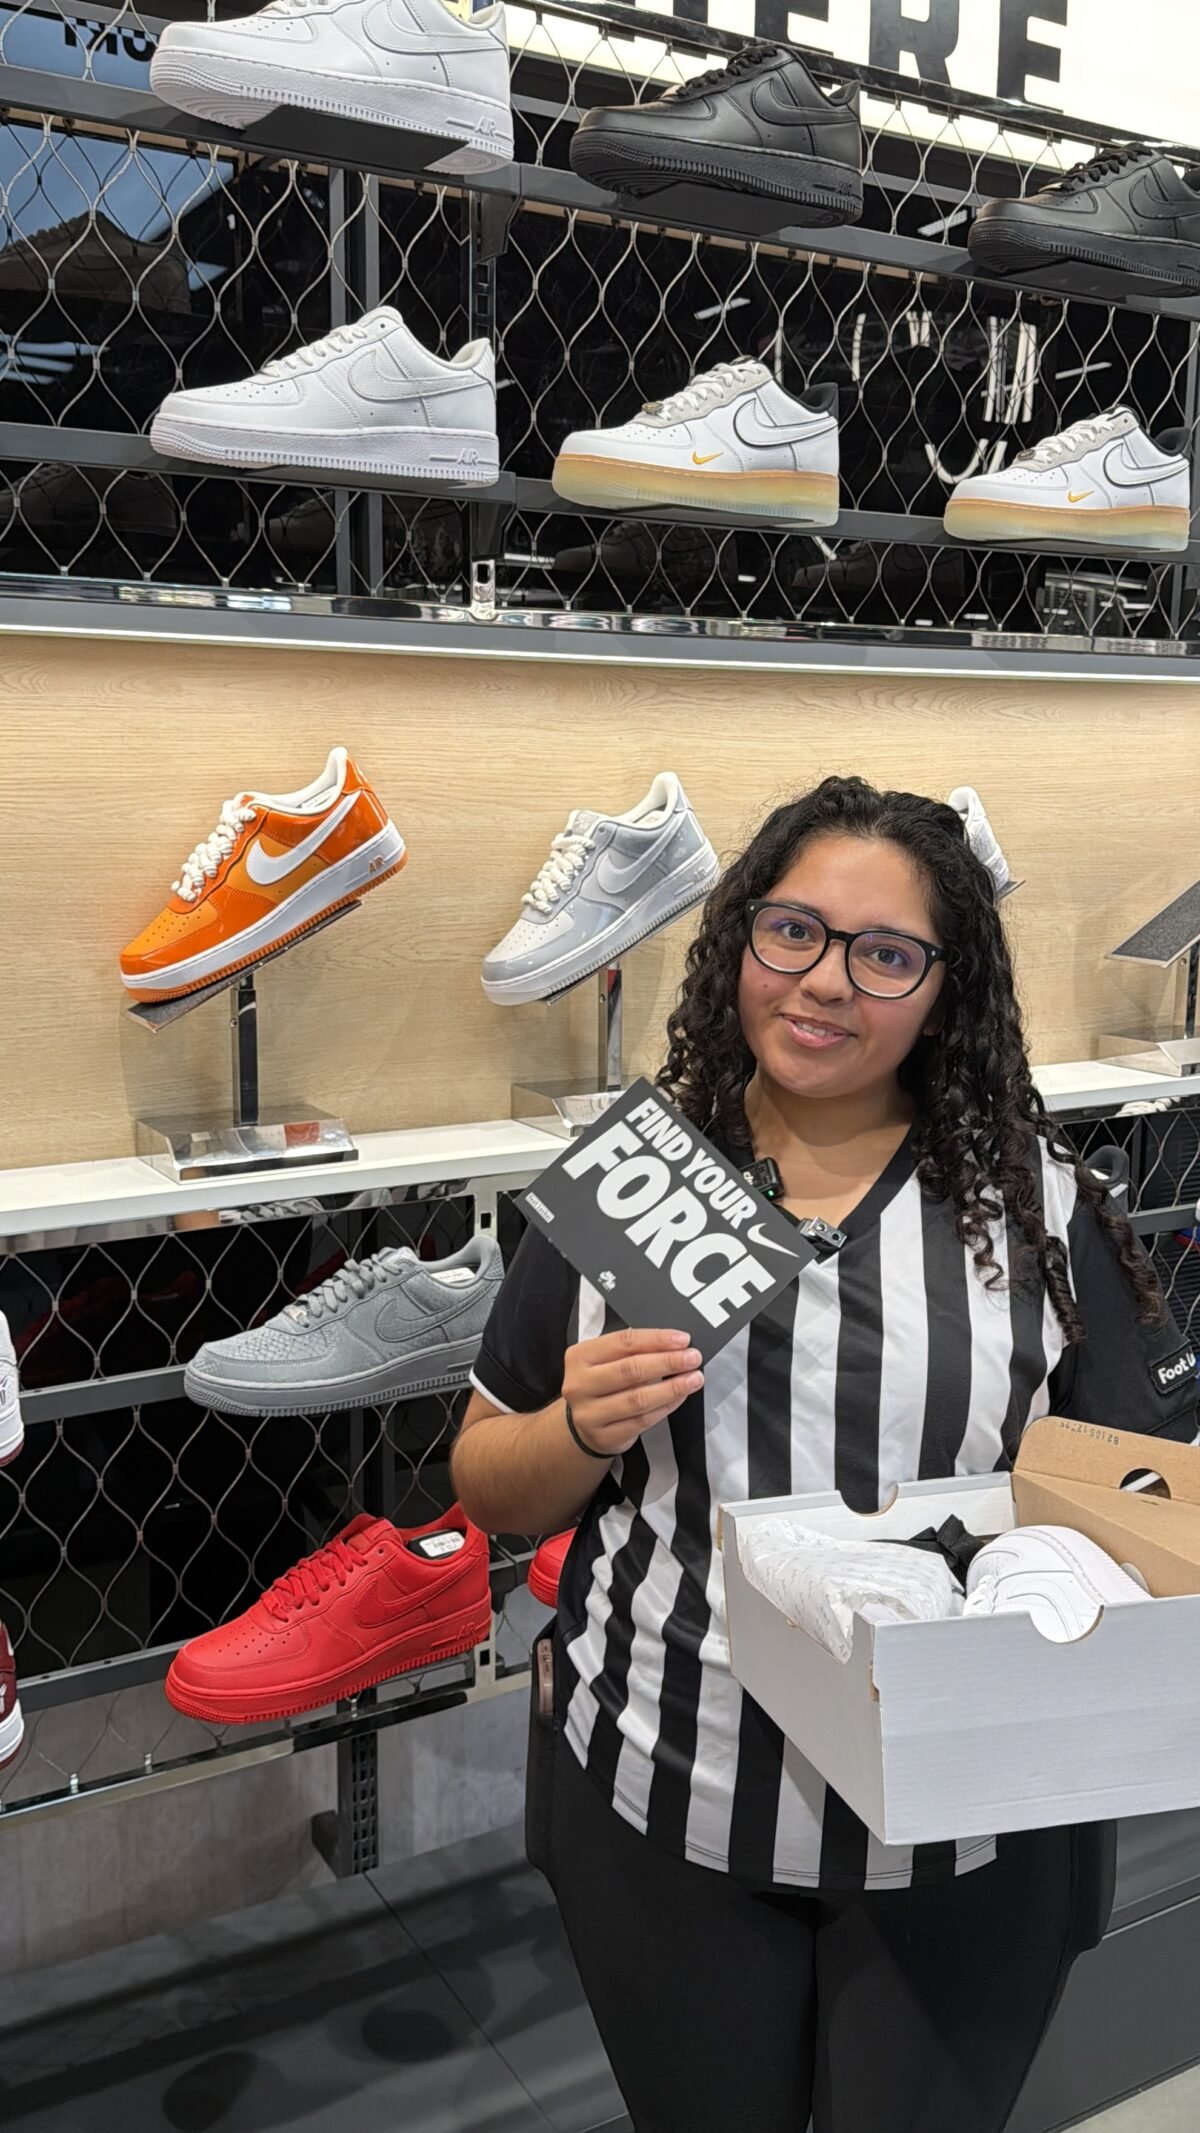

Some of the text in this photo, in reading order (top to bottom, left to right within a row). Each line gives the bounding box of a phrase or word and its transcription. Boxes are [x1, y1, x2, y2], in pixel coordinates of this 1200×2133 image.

[562, 1121, 776, 1329] FORCE
[625, 1097, 758, 1230] FIND YOUR
[1158, 1358, 1189, 1384] Foot
